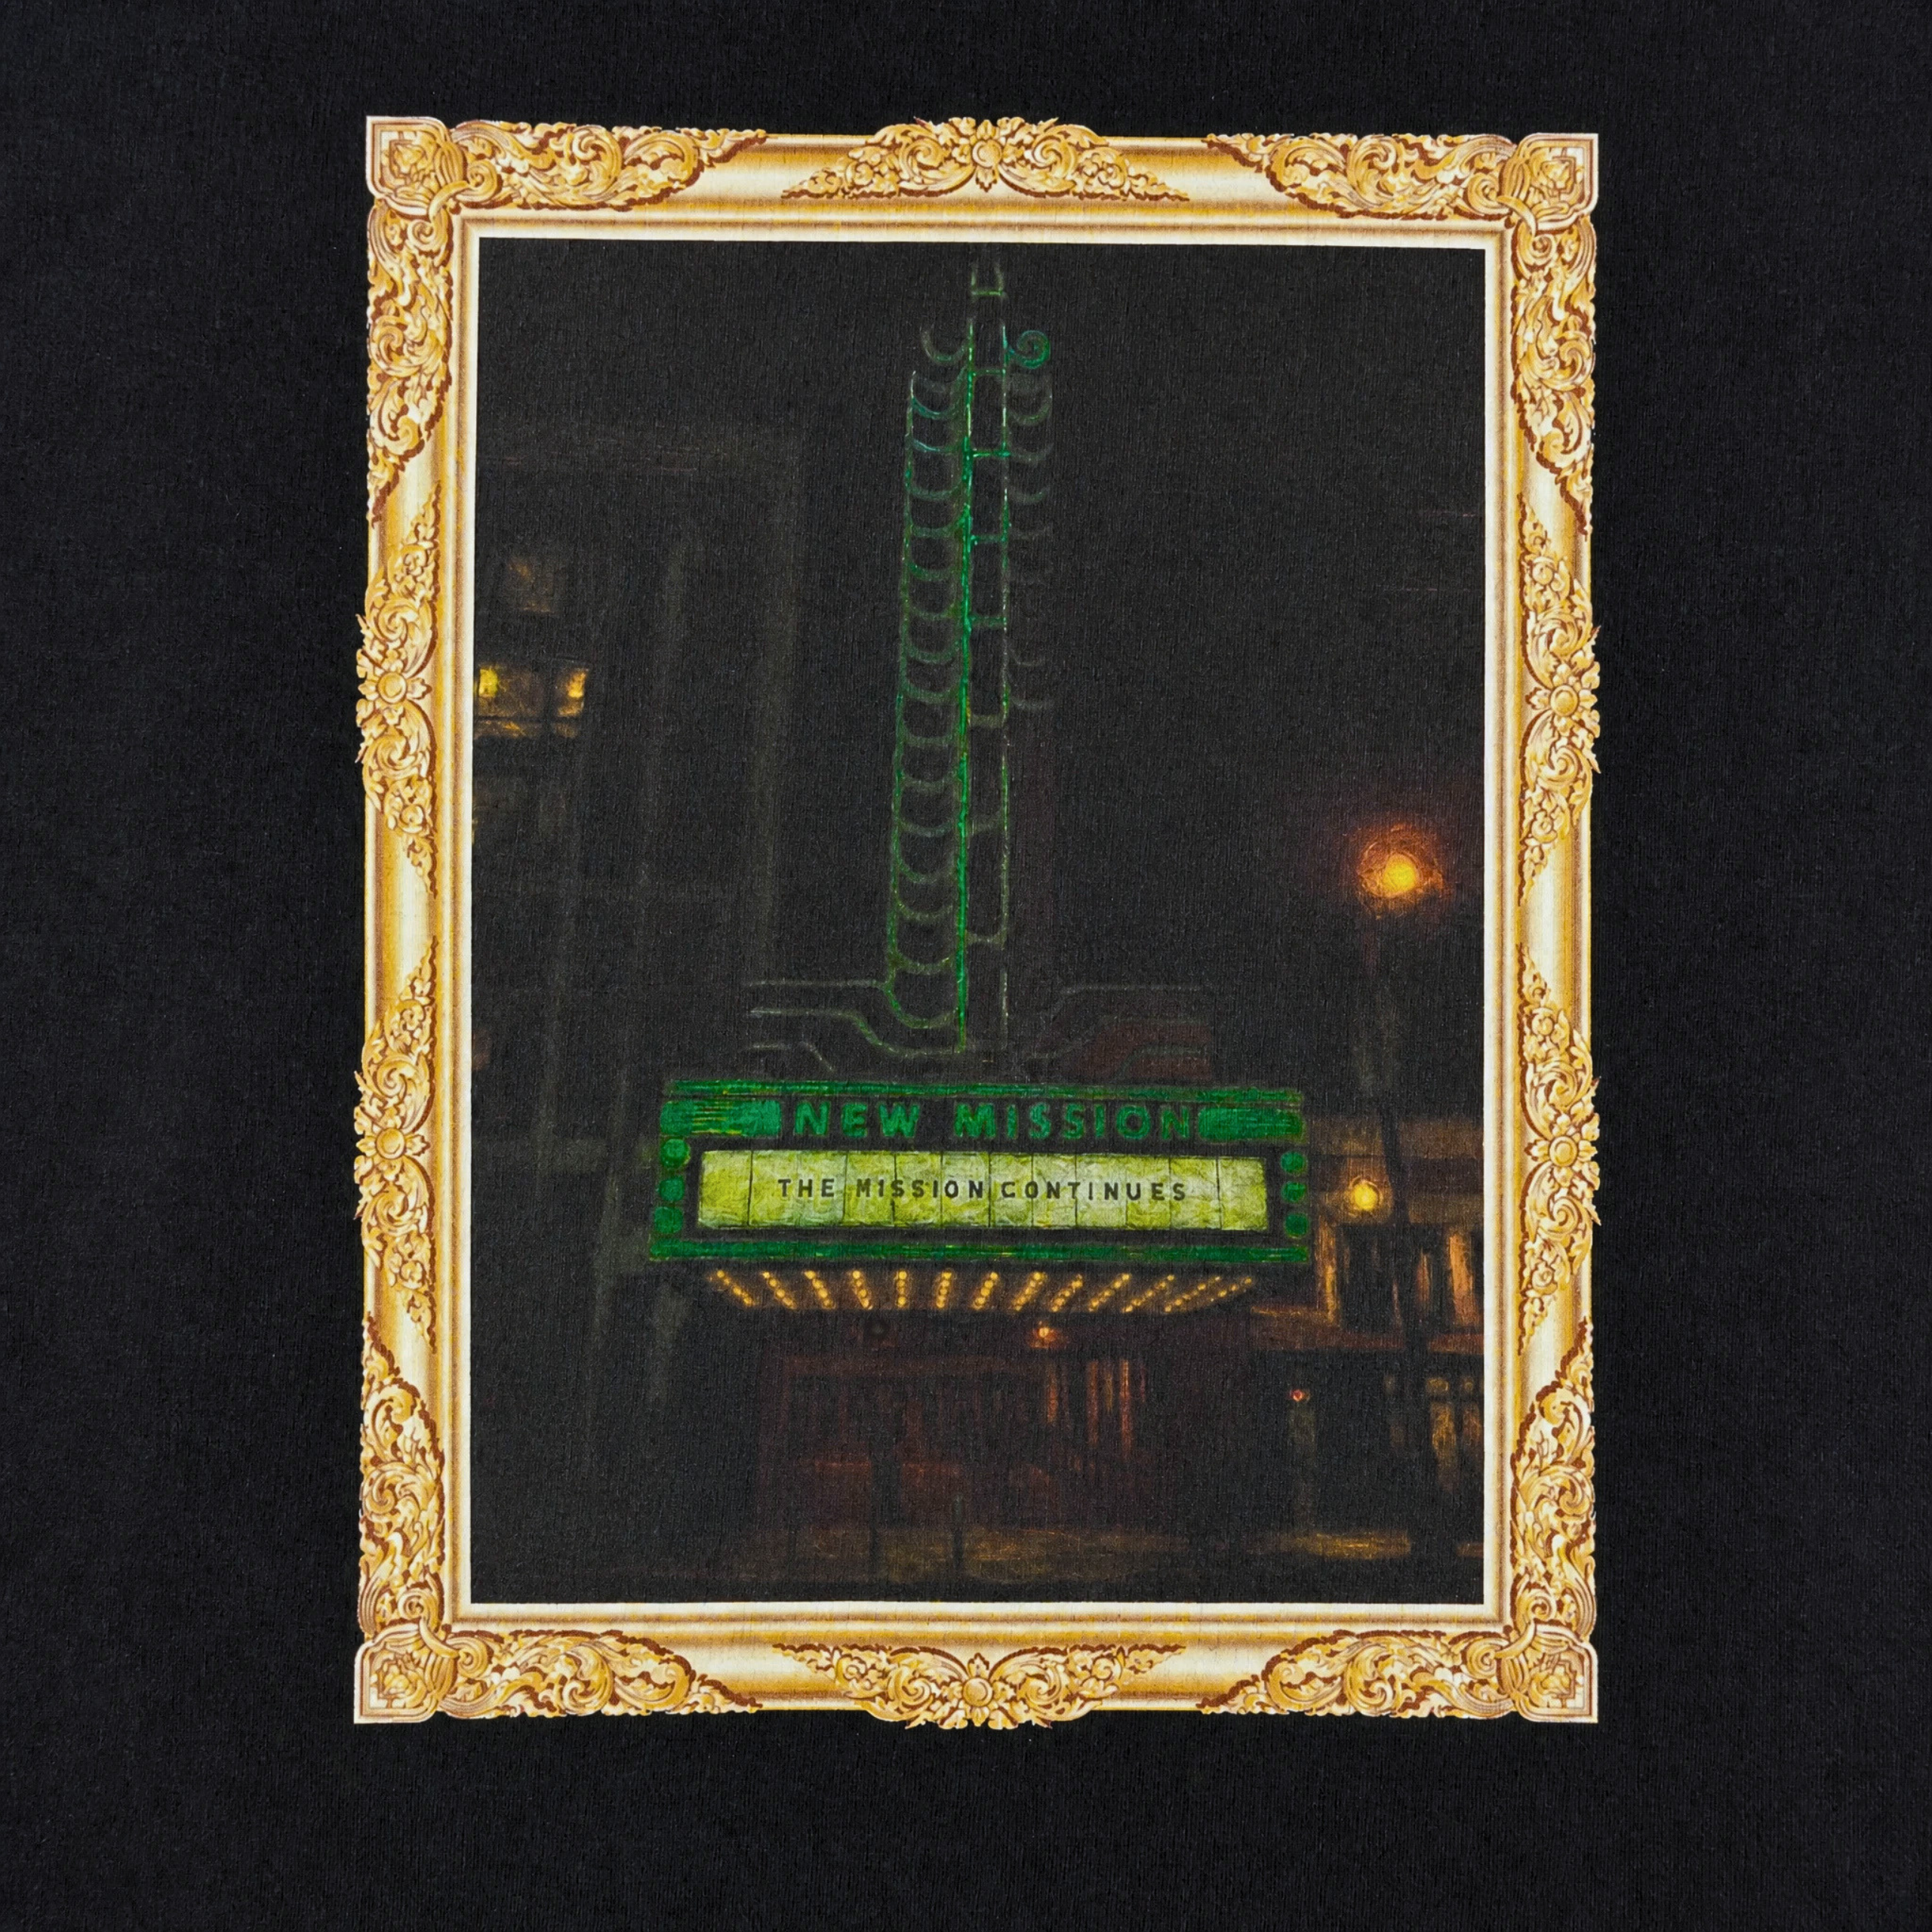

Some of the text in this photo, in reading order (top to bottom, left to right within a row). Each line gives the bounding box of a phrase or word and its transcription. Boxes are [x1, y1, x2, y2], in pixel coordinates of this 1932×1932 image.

[795, 1101, 1190, 1140] NEW MISSION
[777, 1178, 1186, 1201] THE MISSION CONTINUES
